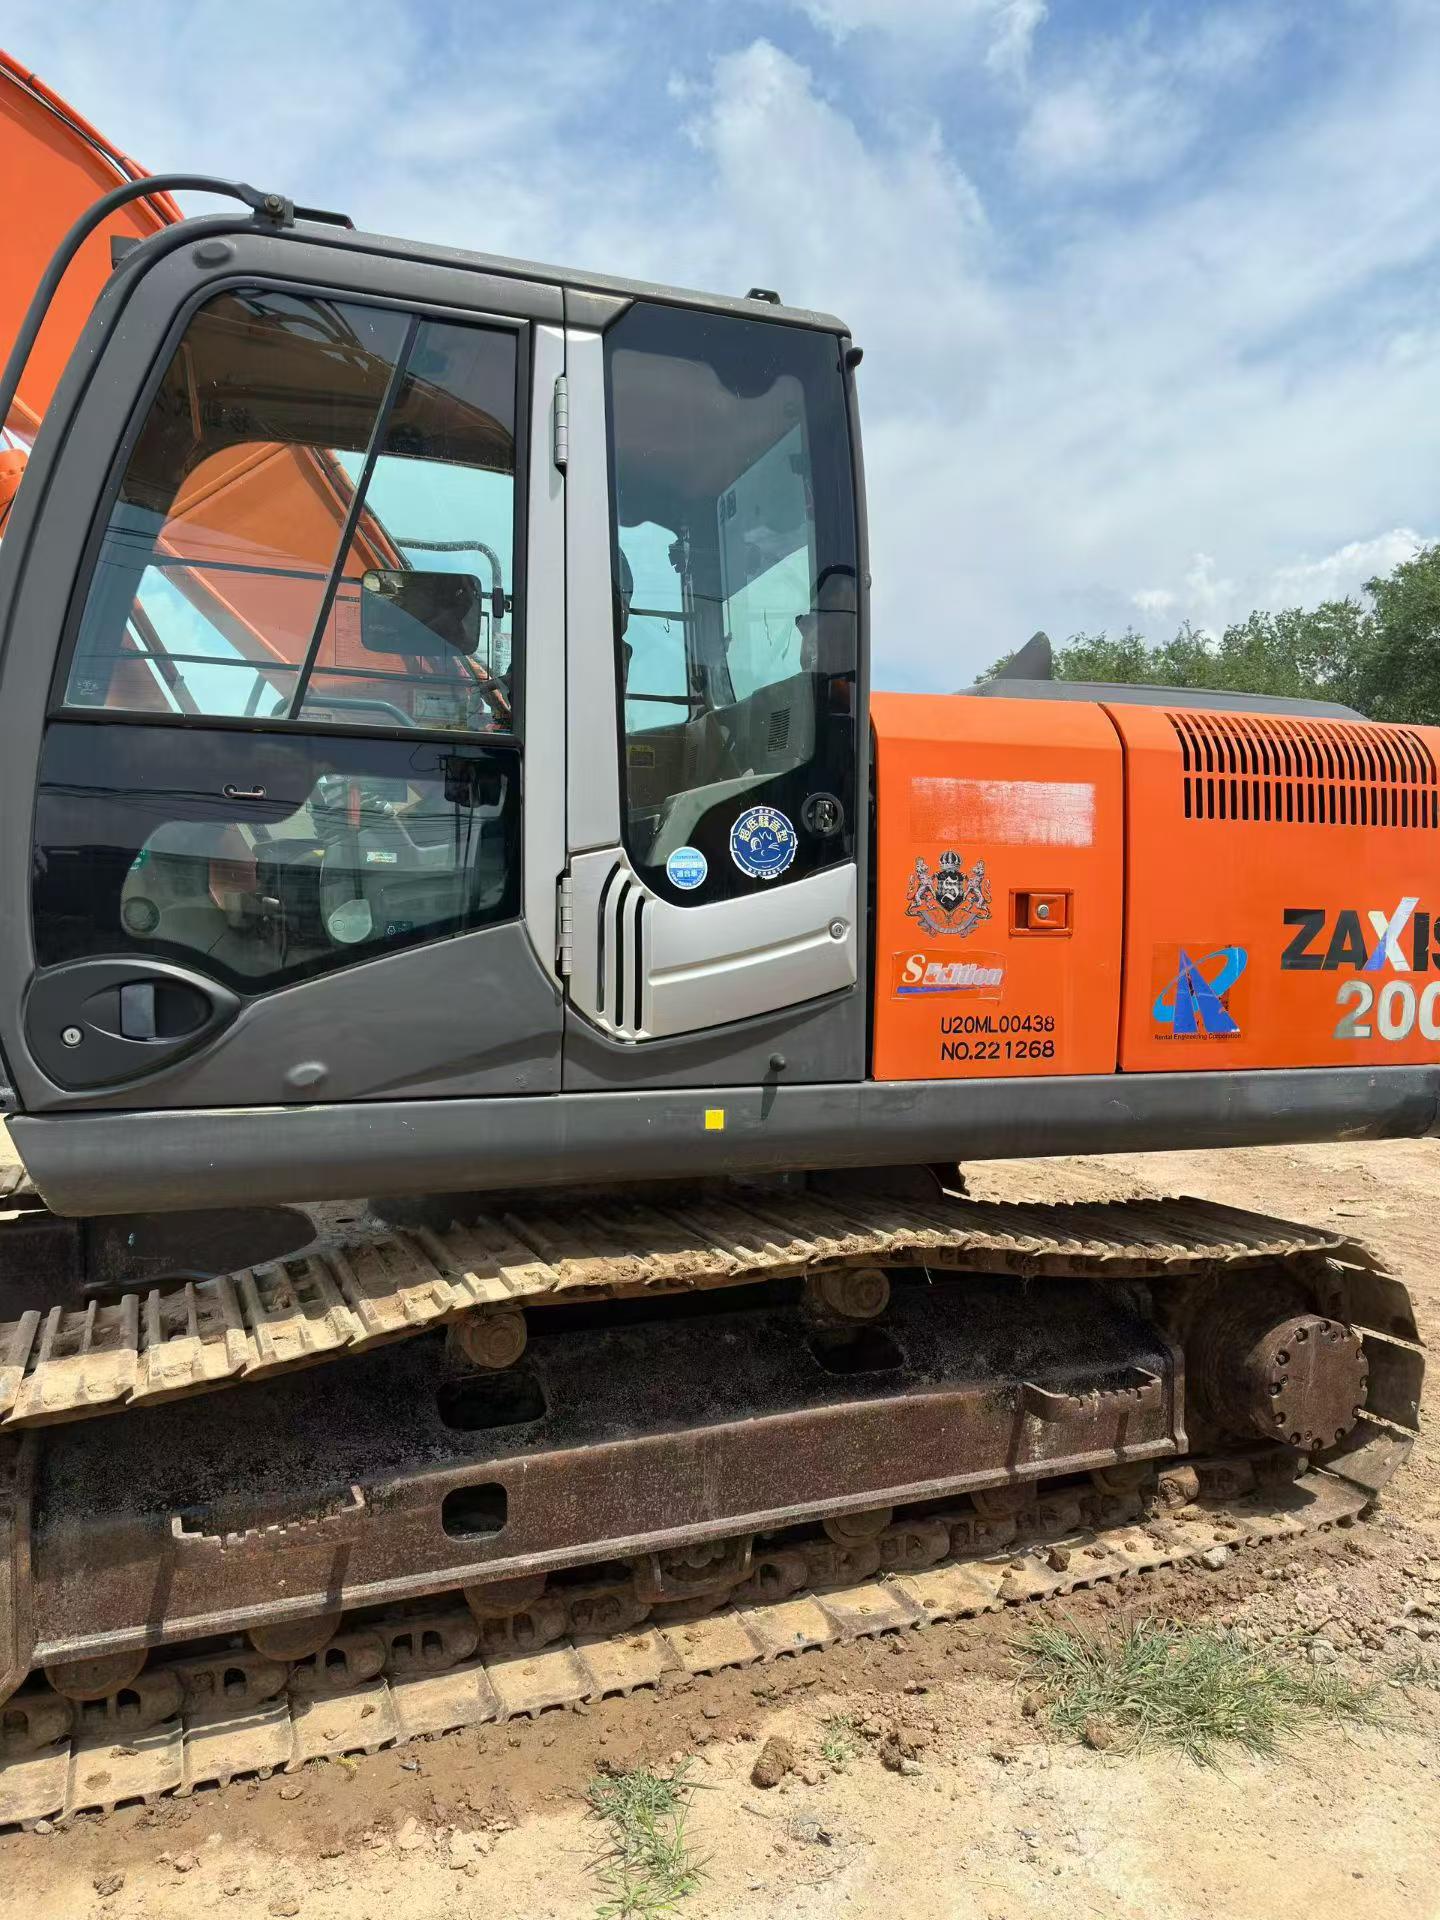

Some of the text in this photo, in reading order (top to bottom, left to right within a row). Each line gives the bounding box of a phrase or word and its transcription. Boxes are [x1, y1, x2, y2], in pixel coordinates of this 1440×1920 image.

[1280, 896, 1440, 972] ZAXI
[941, 1015, 1055, 1034] U20ML00438
[1173, 1033, 1208, 1041] Engineering
[1208, 1032, 1242, 1040] Corporation
[941, 1040, 1055, 1060] NO.221268
